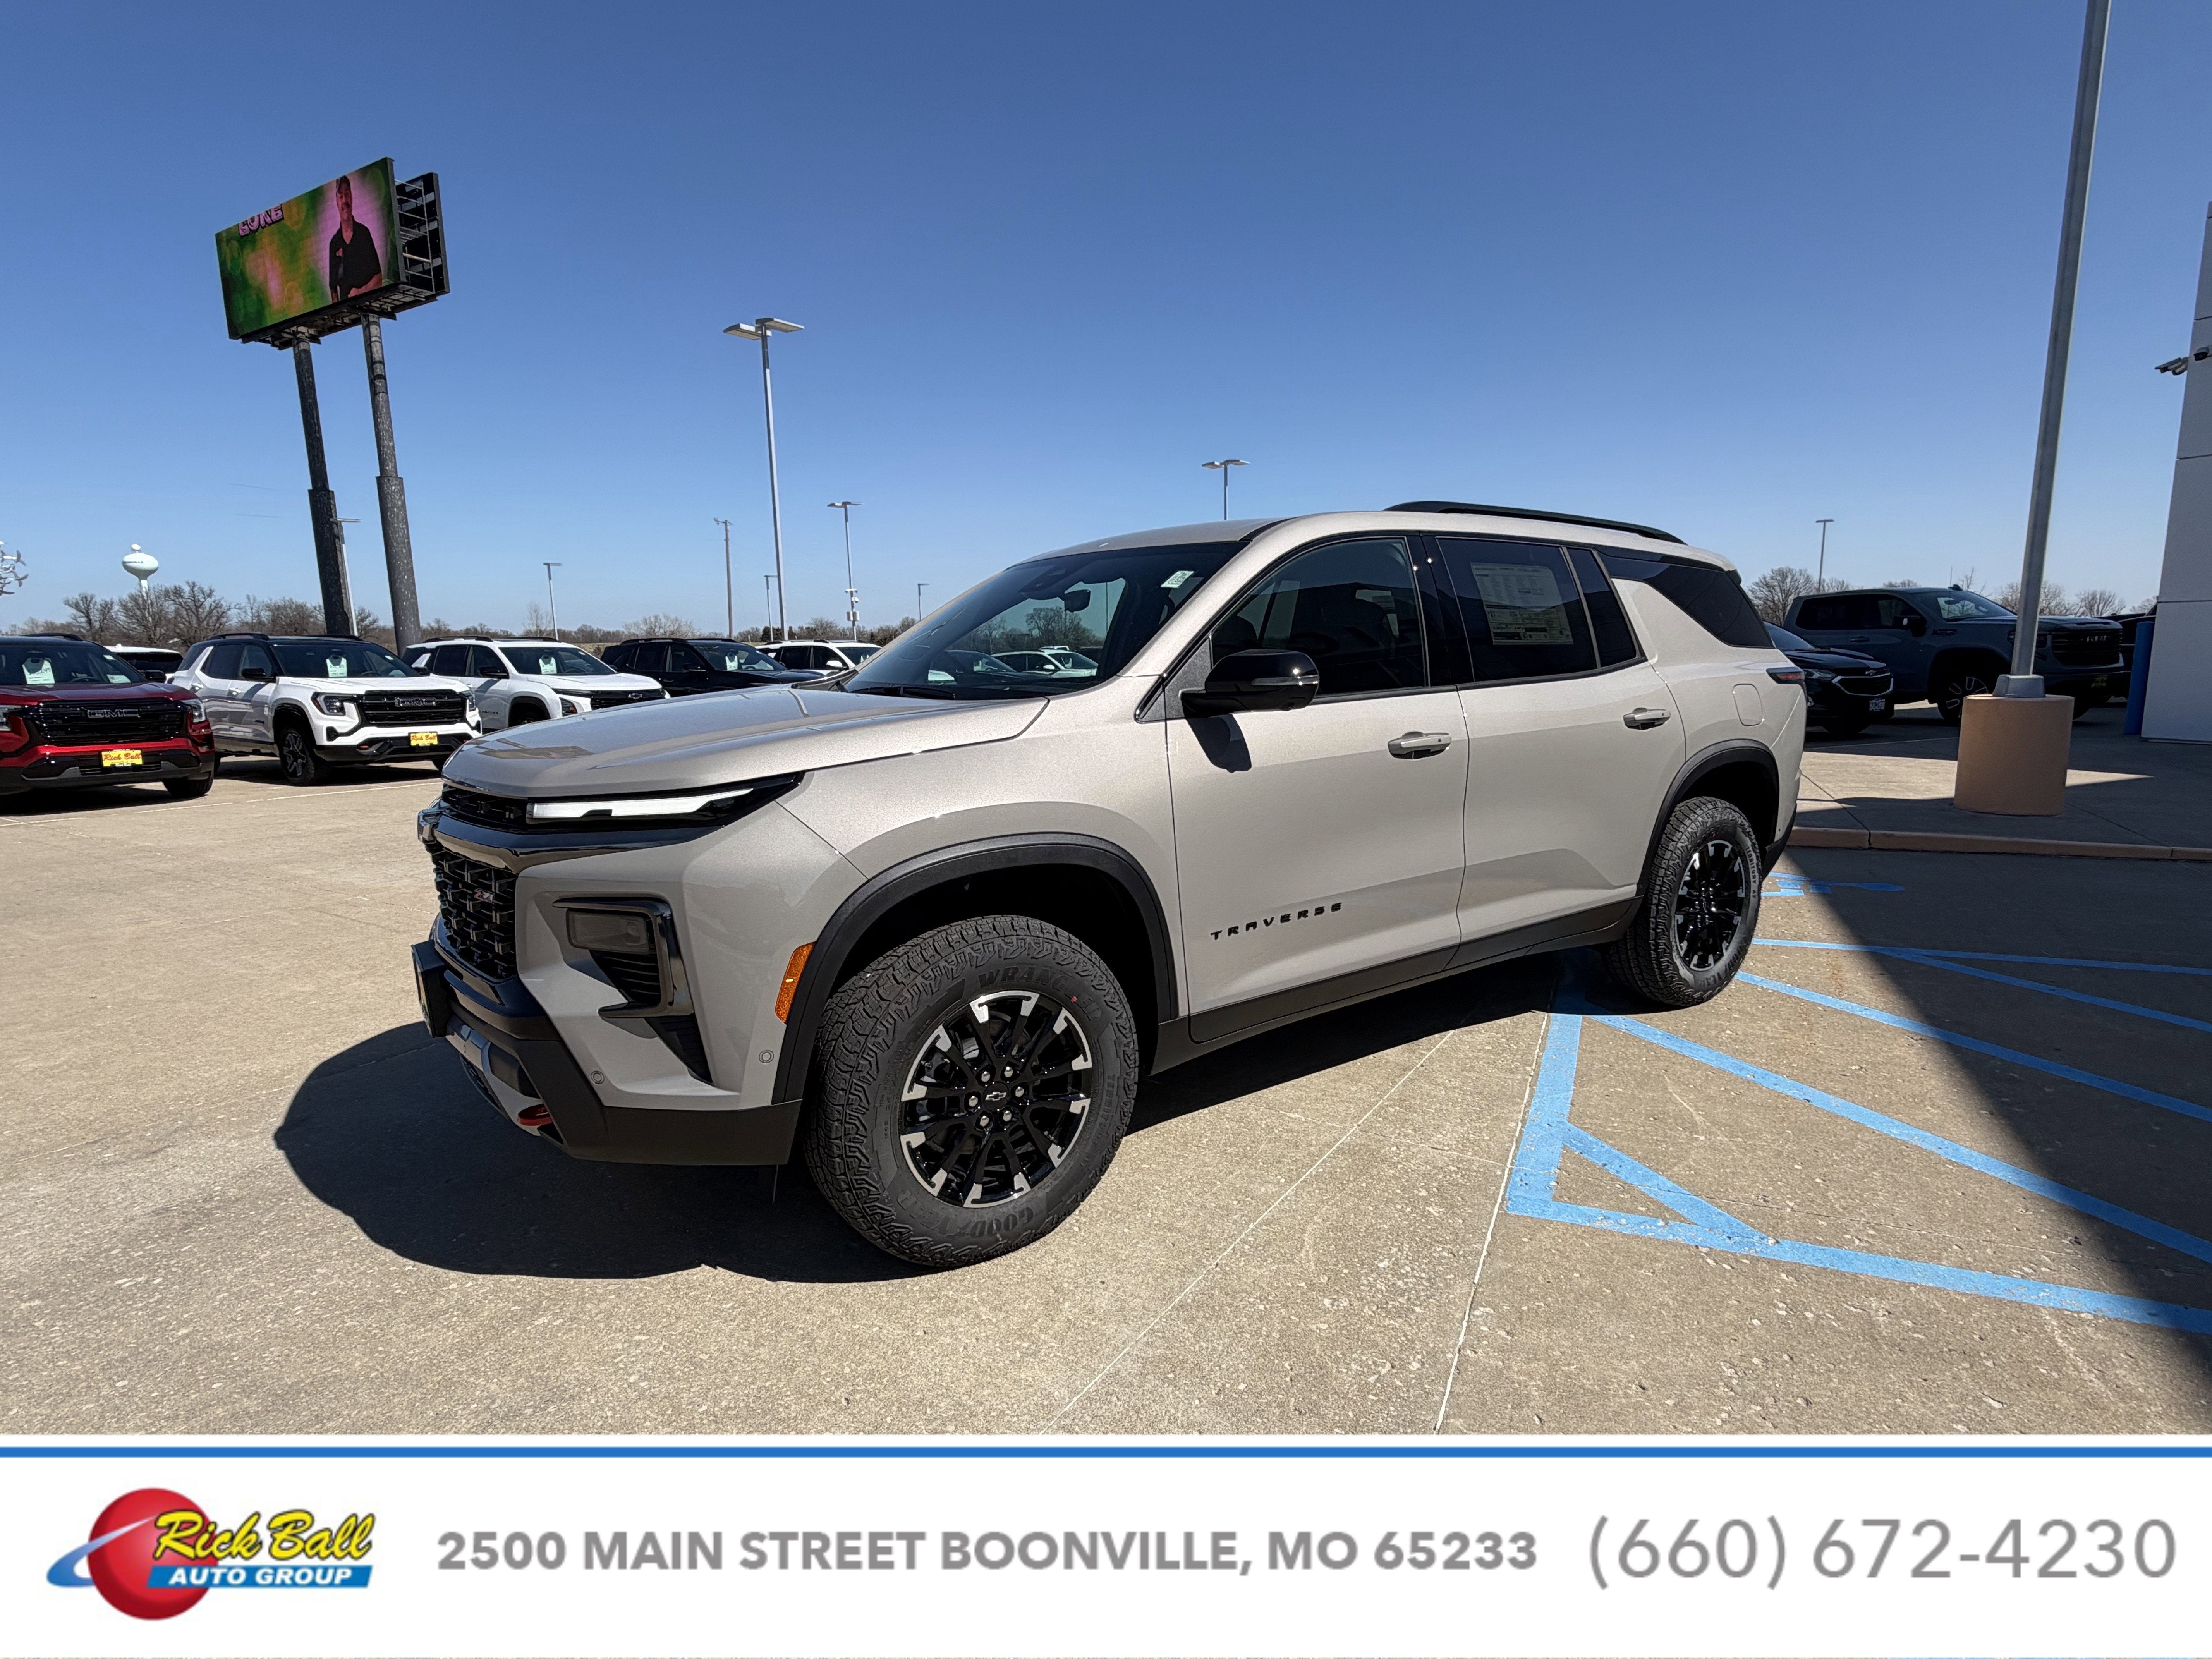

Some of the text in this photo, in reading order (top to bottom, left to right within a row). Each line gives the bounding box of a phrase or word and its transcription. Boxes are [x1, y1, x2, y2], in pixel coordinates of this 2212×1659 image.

[88, 709, 139, 718] GMC
[103, 753, 122, 761] Rick
[1210, 902, 1342, 941] TRAVERSE
